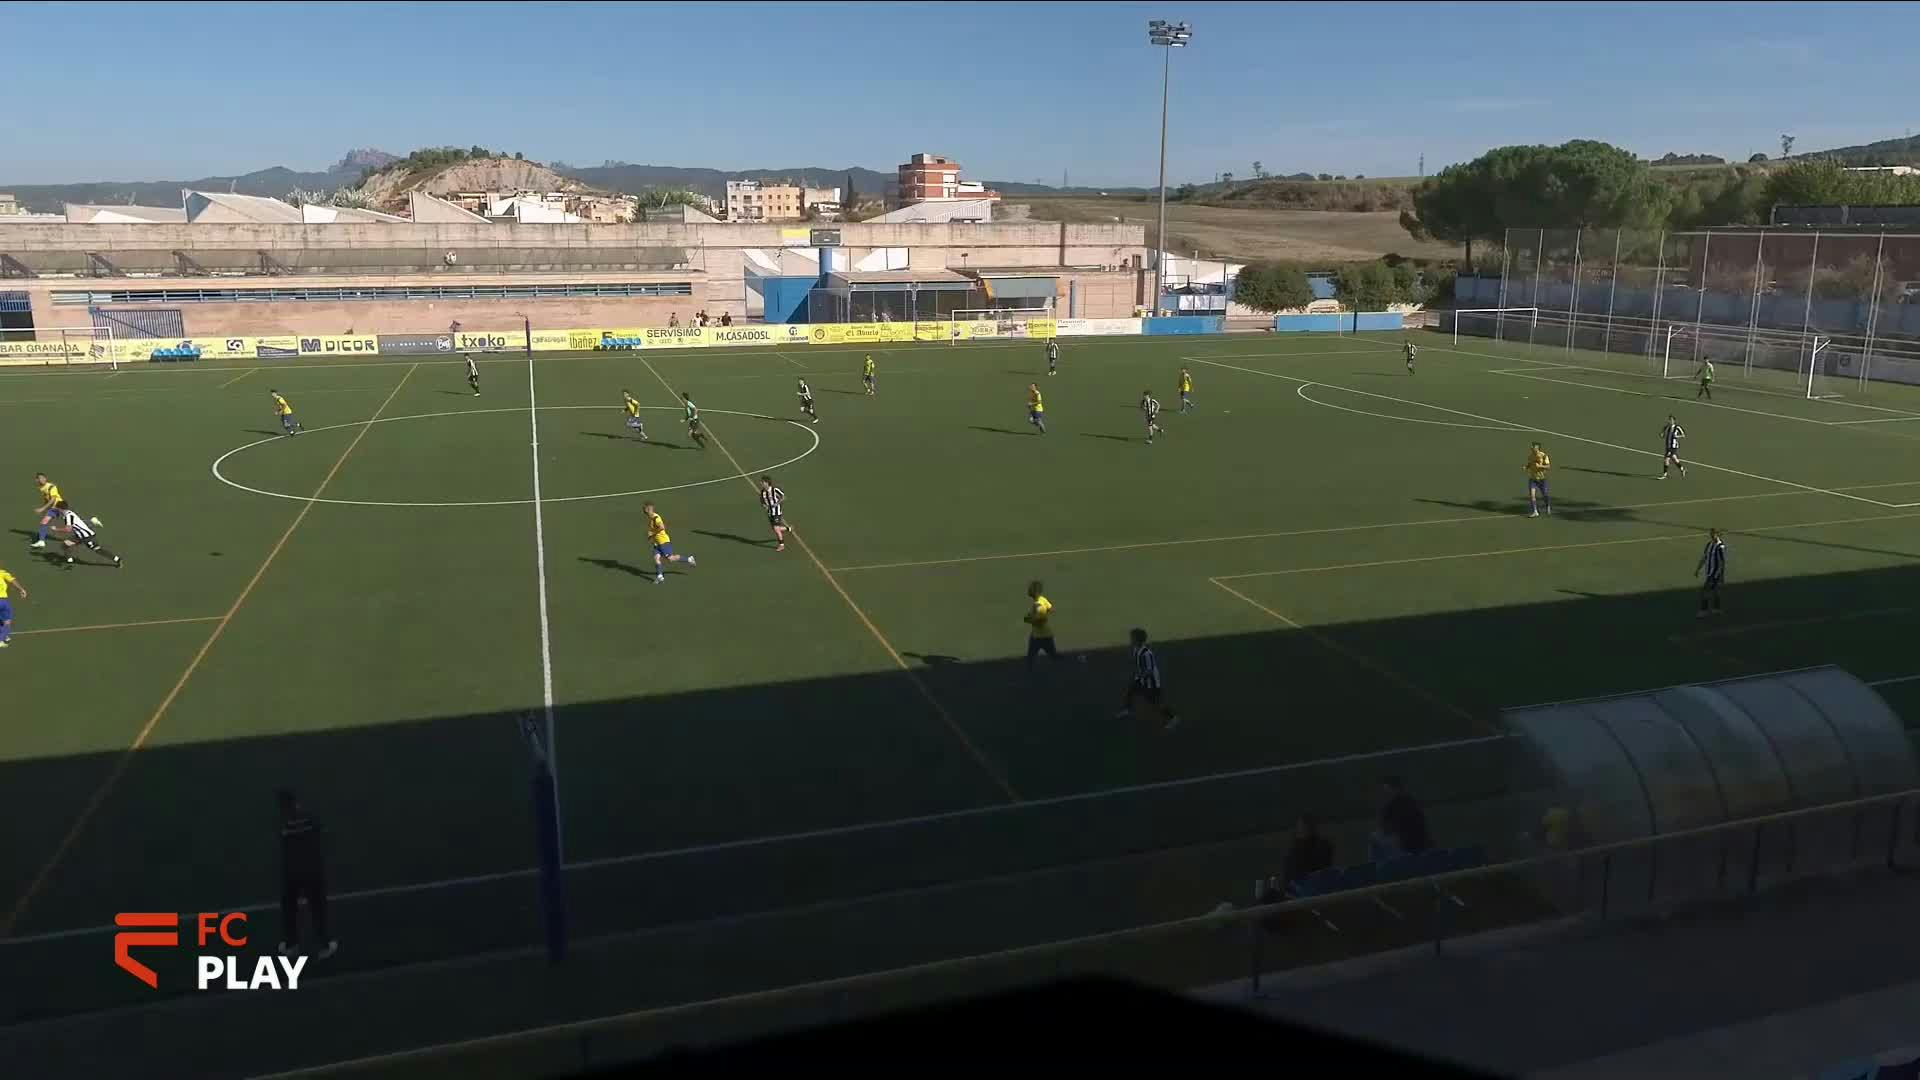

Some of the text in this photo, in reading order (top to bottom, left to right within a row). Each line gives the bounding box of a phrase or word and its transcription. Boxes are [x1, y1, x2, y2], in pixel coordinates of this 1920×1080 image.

[646, 328, 702, 338] SERVISIMO
[461, 333, 506, 347] txoko
[0, 344, 80, 353] BAR GRANADA
[325, 340, 375, 351] DICOR
